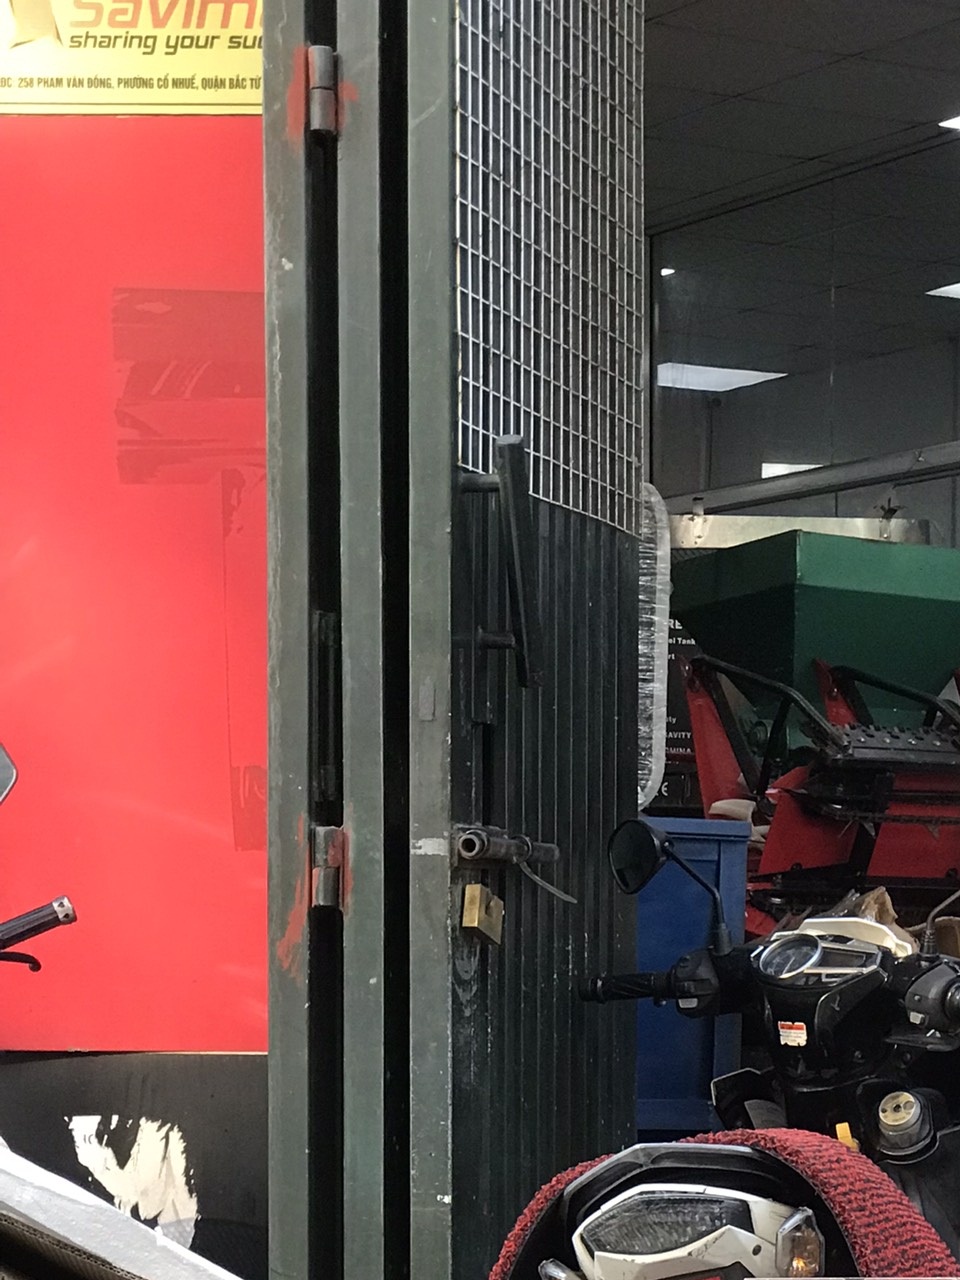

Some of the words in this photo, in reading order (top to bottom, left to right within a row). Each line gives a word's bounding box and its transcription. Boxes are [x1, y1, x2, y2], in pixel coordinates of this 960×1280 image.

[69, 31, 157, 56] sharing
[165, 34, 220, 56] your
[18, 77, 34, 88] 258
[666, 731, 692, 739] AVITY
